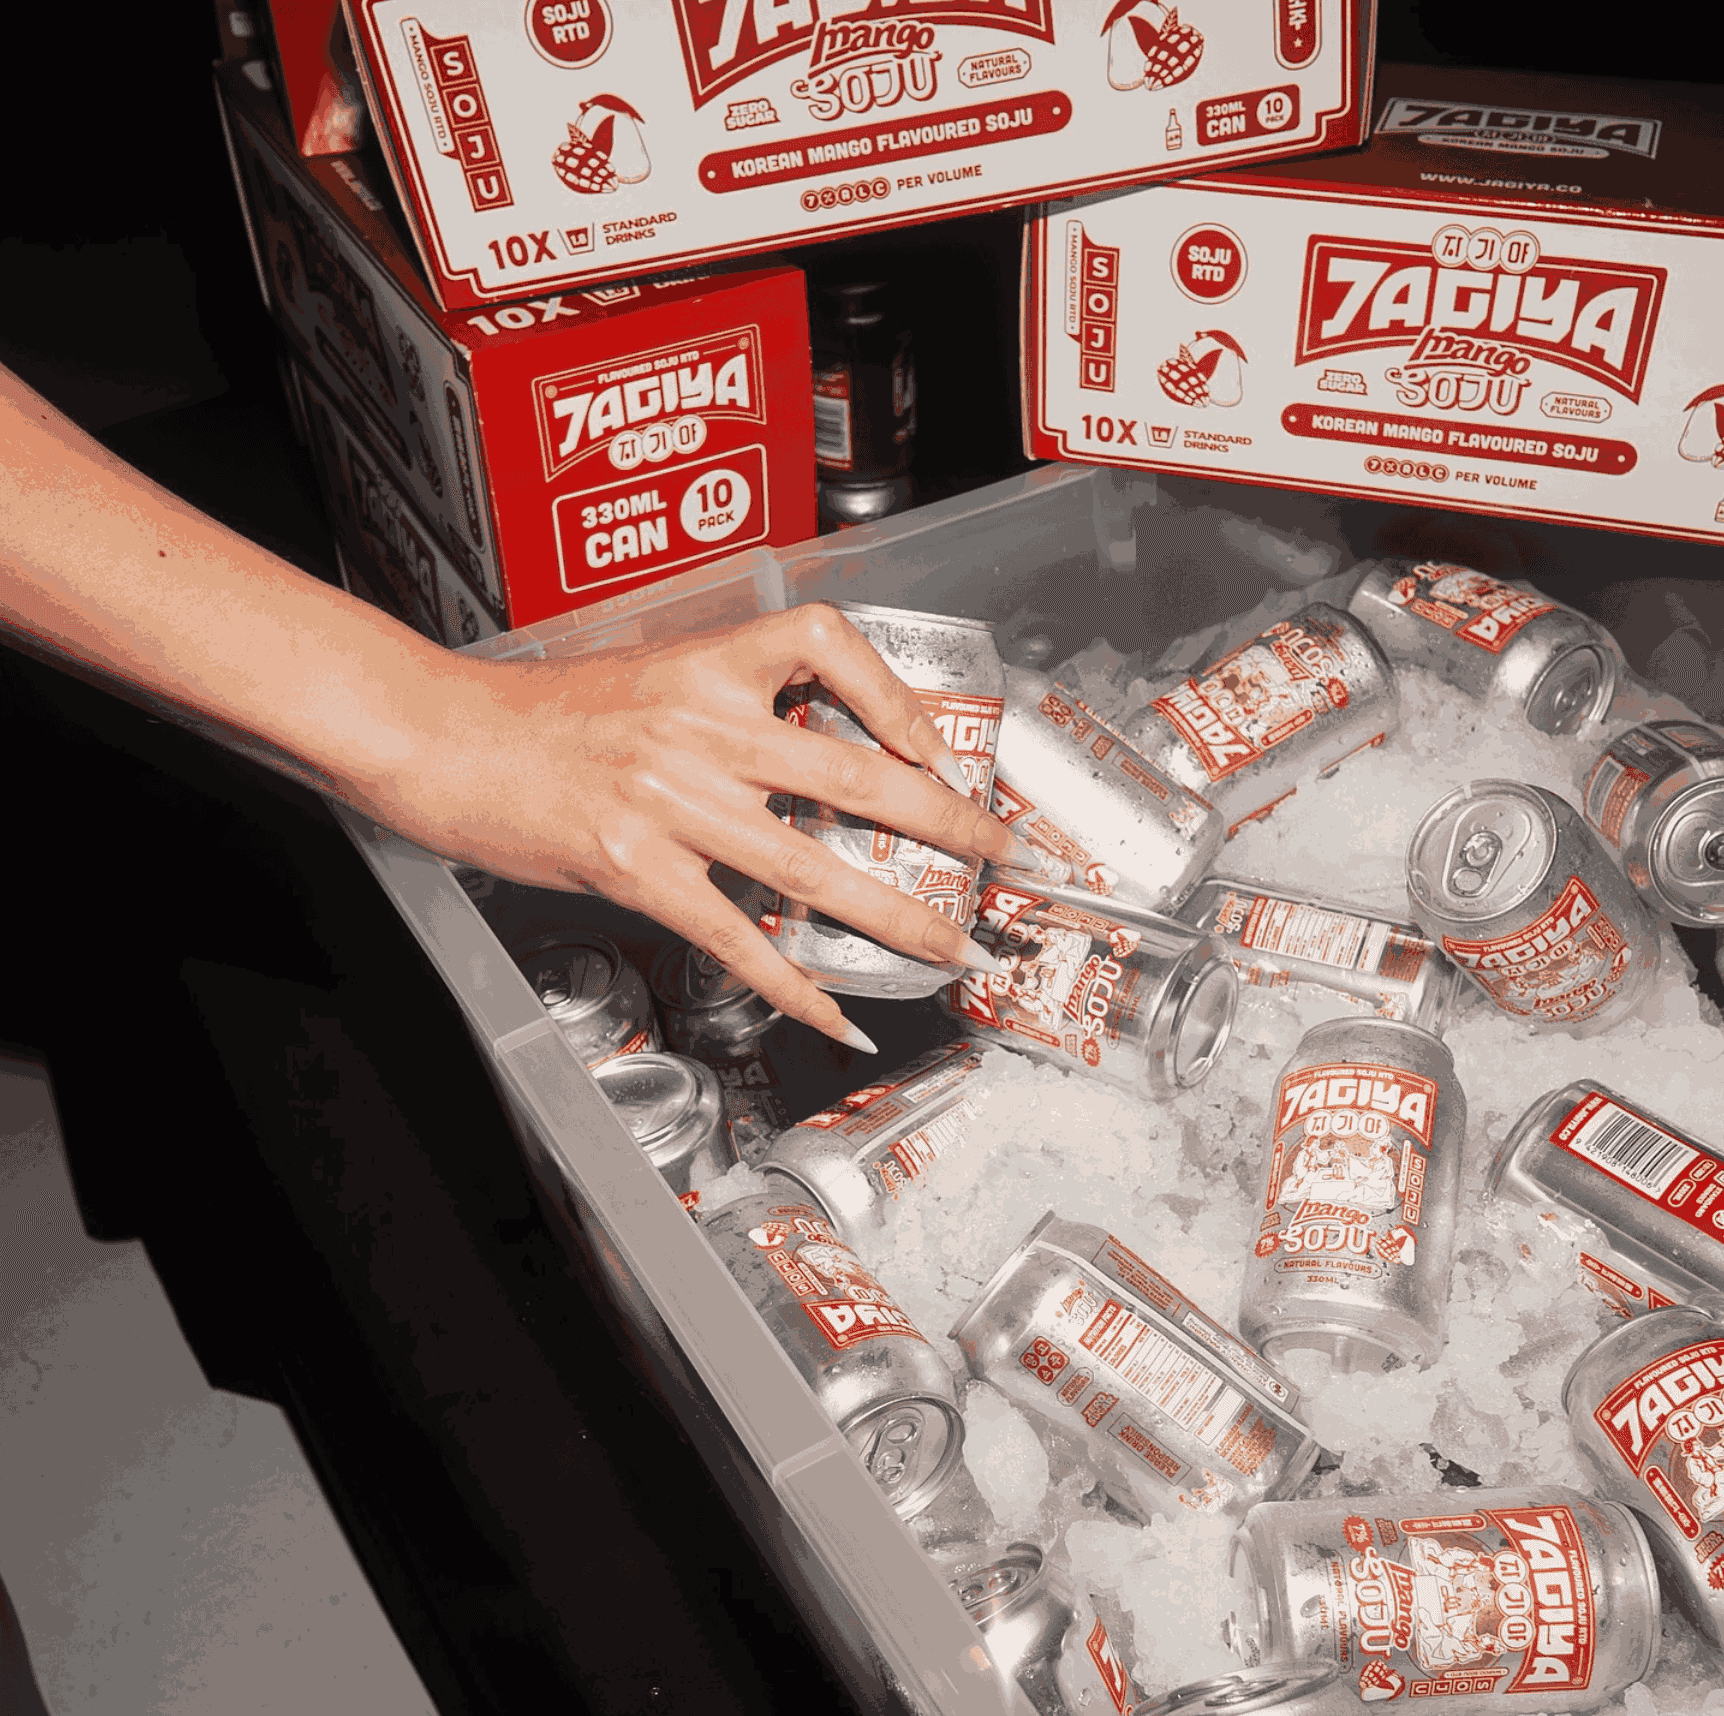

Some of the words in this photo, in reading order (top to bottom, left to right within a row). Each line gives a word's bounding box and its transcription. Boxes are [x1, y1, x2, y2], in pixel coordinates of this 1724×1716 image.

[542, 0, 591, 25] SOJU
[552, 22, 590, 44] RTD
[808, 20, 936, 68] mango
[968, 64, 1022, 83] FLAVOURS
[970, 55, 1018, 72] NATURAL
[408, 33, 432, 82] MANGO
[423, 82, 440, 114] SOJU
[432, 114, 449, 140] RTD
[790, 50, 944, 121] SOJU
[725, 109, 778, 130] SUGAR
[729, 100, 768, 116] ZERO
[1205, 101, 1247, 118] 330ML
[1264, 97, 1284, 115] 10
[1264, 114, 1286, 124] PACK
[443, 49, 503, 202] SOJU
[1205, 114, 1246, 139] CAN
[731, 151, 804, 180] KOREAN
[807, 137, 873, 166] MANGO
[875, 116, 981, 152] FLAVOURED
[984, 106, 1034, 133] SOJU
[896, 178, 925, 191] PER
[926, 164, 983, 184] VOLUME
[1420, 172, 1583, 194] WWW.JAGIYA.CO
[602, 211, 678, 234] STANDARD
[604, 227, 657, 246] DRINKS
[1443, 236, 1530, 264] 자기야
[488, 230, 559, 271] 10X
[1068, 234, 1079, 274] MANGO
[1188, 245, 1232, 265] SOJU
[1191, 264, 1225, 282] RTD
[467, 296, 580, 336] 10X
[1087, 256, 1110, 384] SOJU
[1405, 328, 1532, 375] mango
[597, 362, 653, 385] FLAVOURED
[653, 354, 679, 372] SOJU
[680, 350, 700, 366] RTD
[1324, 371, 1361, 385] ZERO
[1319, 380, 1367, 394] SUGAR
[1384, 366, 1532, 417] SOJU
[1550, 405, 1602, 420] FLAVOURS
[1553, 396, 1600, 411] NATURAL
[618, 423, 699, 461] 자기야
[1080, 414, 1138, 447] 10X
[1183, 430, 1253, 447] STANDARD
[1311, 413, 1379, 436] KOREAN
[1382, 421, 1444, 445] MANGO
[1447, 431, 1549, 457] FLAVOURED
[1552, 443, 1600, 463] SOJU
[1183, 440, 1230, 453] DRINKS
[1455, 471, 1481, 484] PER
[1484, 475, 1538, 490] VOLUME
[696, 477, 733, 513] 10
[580, 490, 667, 529] 330ML
[698, 510, 736, 532] PACK
[584, 516, 670, 569] CAN
[1063, 956, 1100, 1021] mango
[1083, 958, 1122, 1038] SOJU
[1357, 1069, 1377, 1078] SOJU
[1575, 1137, 1582, 1145] 9
[1407, 1156, 1424, 1221] SOJU
[1290, 1200, 1372, 1227] mango
[1278, 1223, 1379, 1255] SOJU
[1283, 1260, 1323, 1269] NATURAL
[1325, 1261, 1373, 1275] FLAVOURS
[1633, 1359, 1679, 1390] FLAVOURED
[1678, 1349, 1700, 1364] SOJU
[1702, 1345, 1718, 1357] RTD
[1085, 1393, 1107, 1418] ZERO
[1089, 1394, 1117, 1427] SUGAR
[1118, 1430, 1146, 1453] DRINK
[1142, 1450, 1178, 1479] PLEASE
[1350, 1523, 1366, 1543] 7%
[1567, 1550, 1586, 1600] FLAVOURED
[1577, 1600, 1590, 1625] SOJU
[1348, 1546, 1394, 1659] SOJU
[1381, 1556, 1417, 1651] mango
[1412, 1678, 1491, 1697] SOJU
